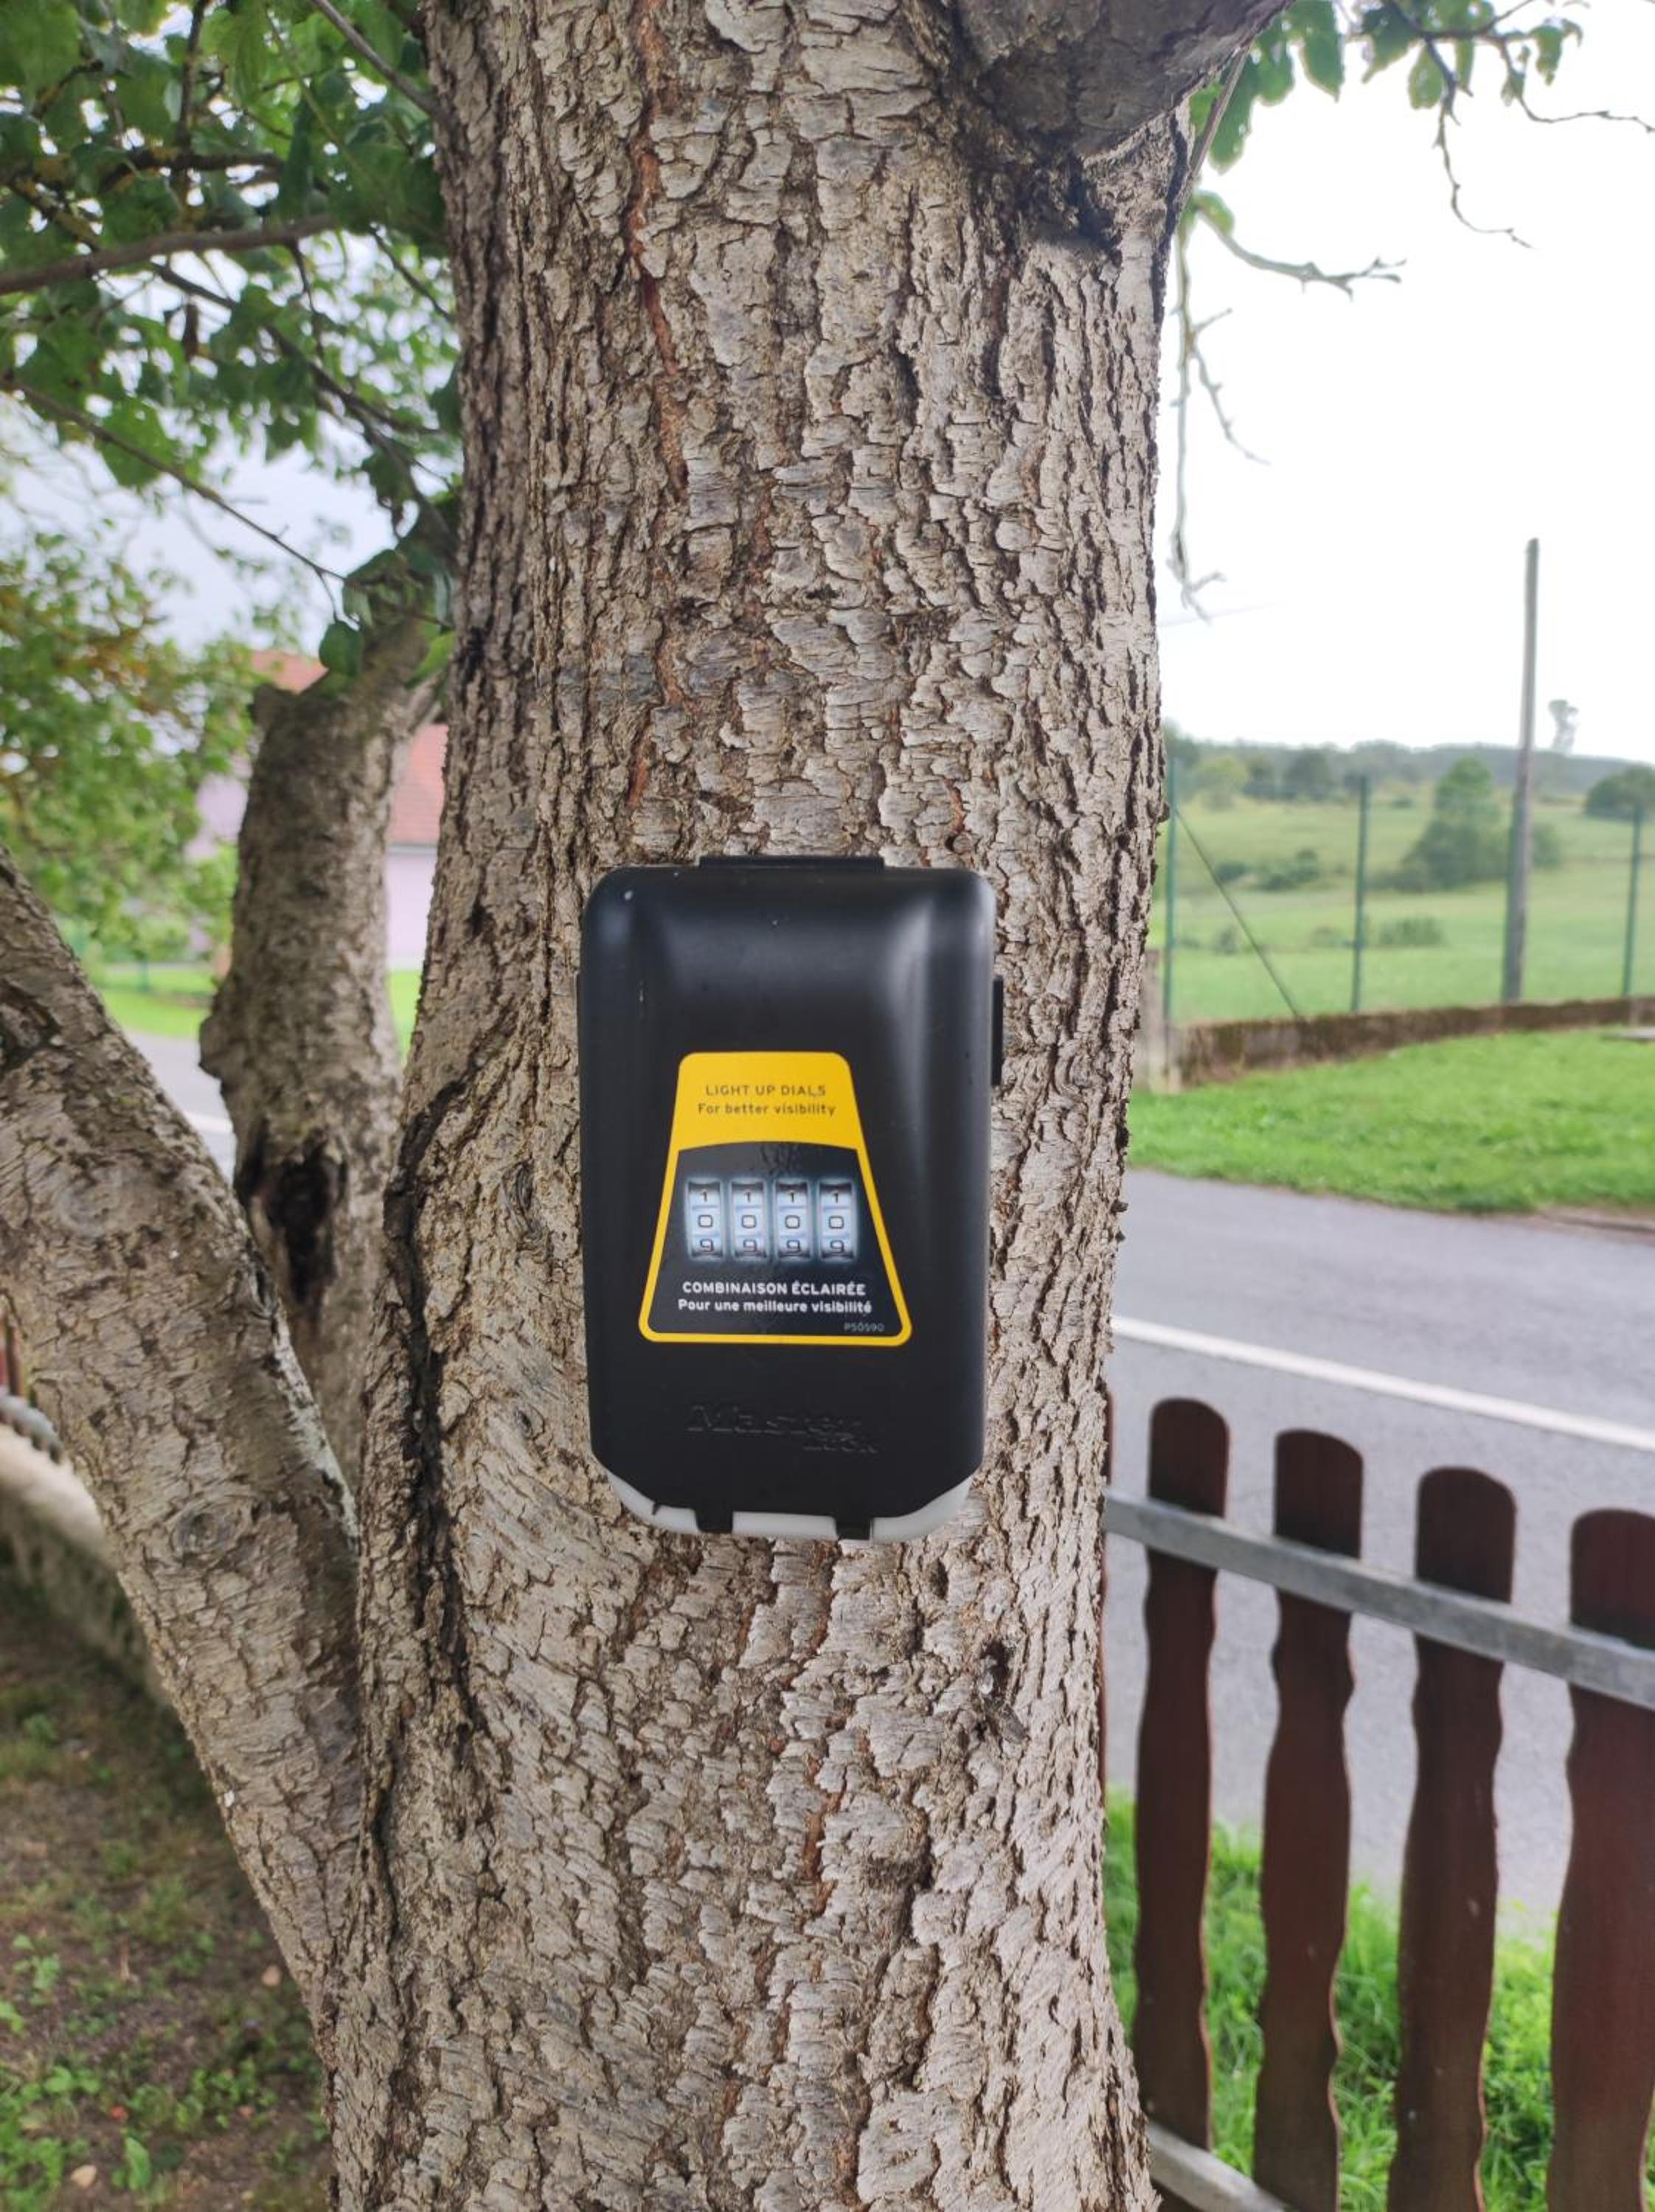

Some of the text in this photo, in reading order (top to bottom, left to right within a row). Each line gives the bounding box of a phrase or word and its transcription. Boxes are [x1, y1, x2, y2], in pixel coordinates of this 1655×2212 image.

[706, 1085, 827, 1097] LIGHT UP DIALS
[698, 1103, 837, 1117] For better visibility
[682, 1281, 866, 1296] COMBINAISON ÉCLAIRÉE
[678, 1298, 872, 1314] Pour une meilleure visibilité
